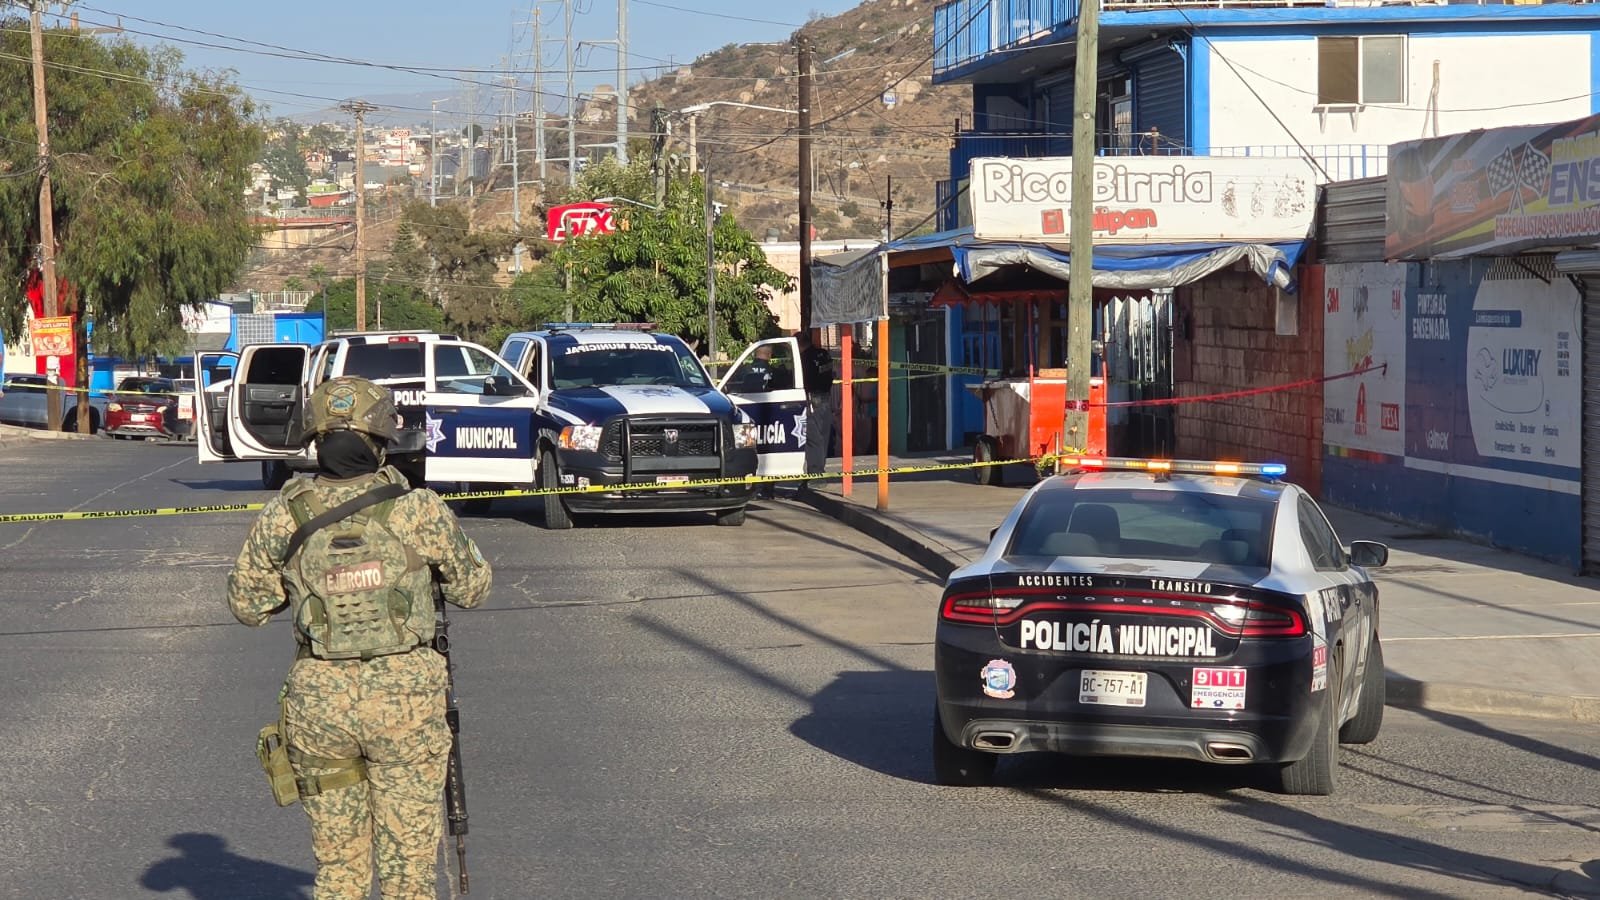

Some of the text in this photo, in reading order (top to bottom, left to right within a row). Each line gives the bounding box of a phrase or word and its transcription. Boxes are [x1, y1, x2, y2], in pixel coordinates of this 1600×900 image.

[1092, 163, 1212, 202] Birria
[1041, 208, 1064, 235] El
[1326, 287, 1339, 314] 3M
[1417, 293, 1447, 316] PINTURAS
[1412, 317, 1451, 341] ENSENADA
[1502, 348, 1542, 377] LUXURY
[455, 426, 518, 450] MUNICIPAL
[1018, 575, 1212, 594] ACCIDENTES TRANSITO
[1020, 618, 1217, 657] POLICÍA MUNICIPAL
[1082, 677, 1143, 695] BC-757-A1
[1193, 690, 1244, 699] EMERGENCIAS
